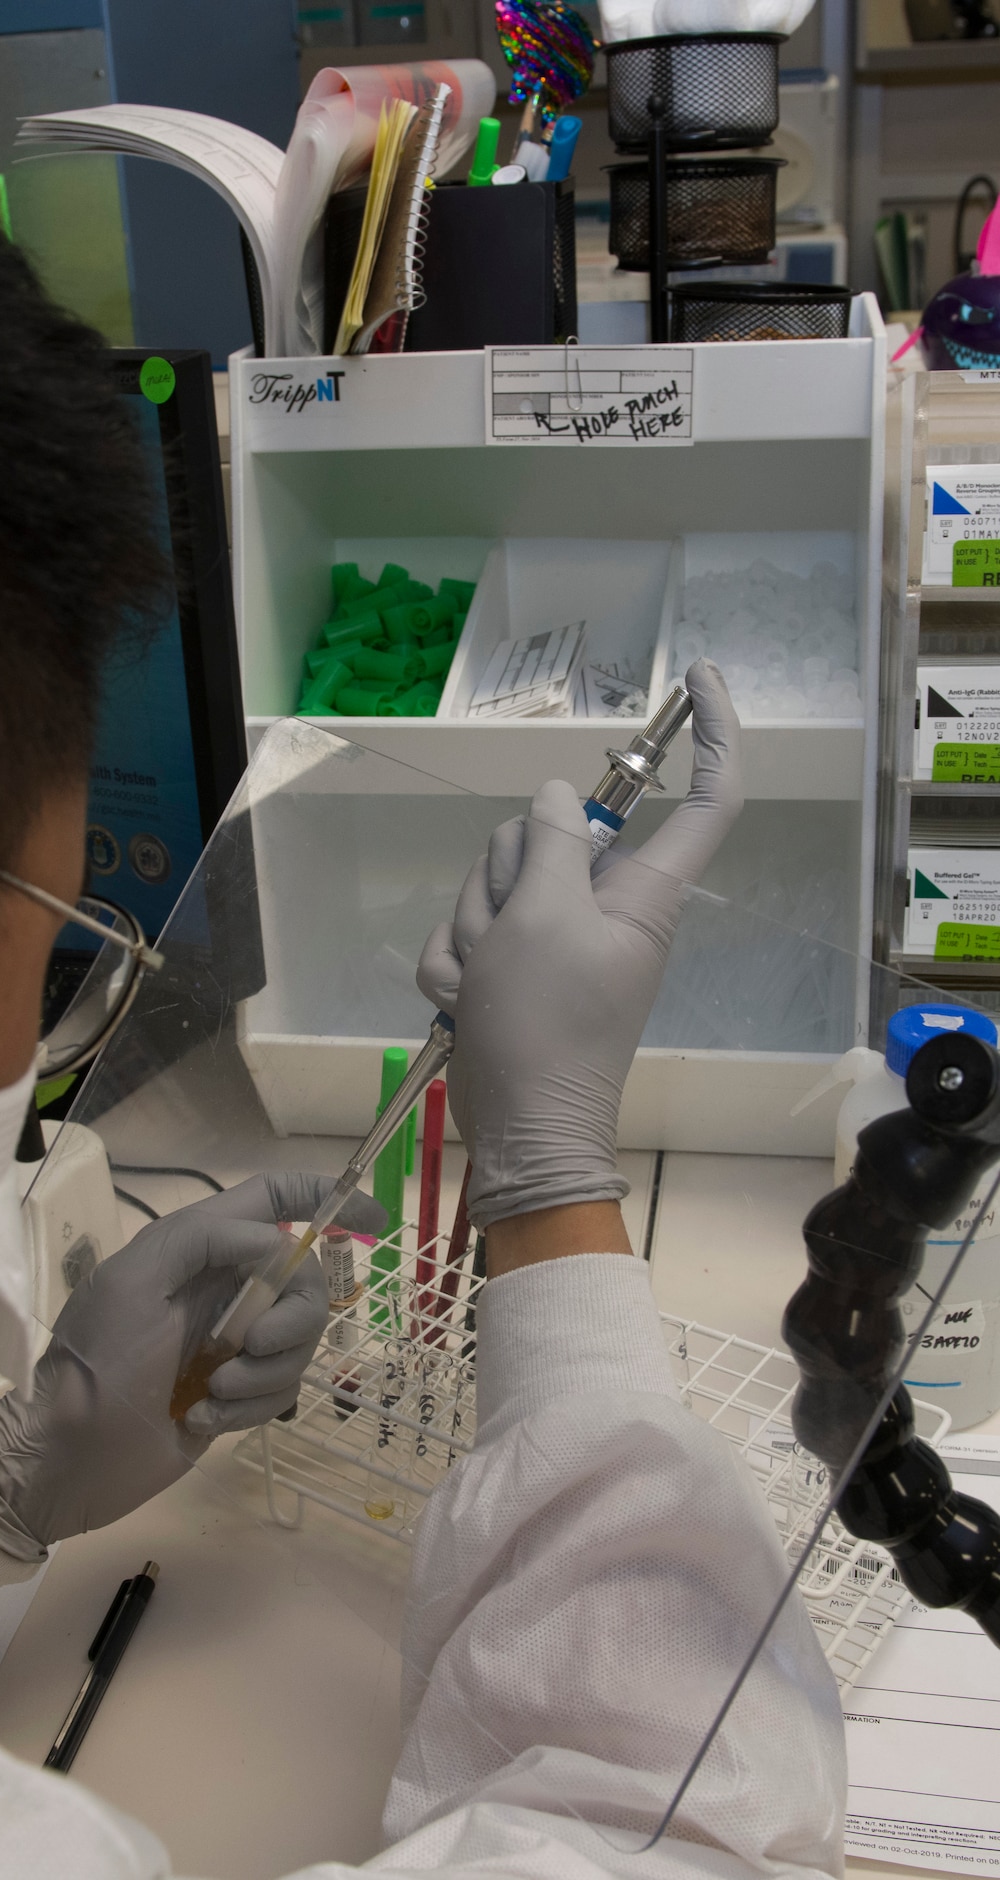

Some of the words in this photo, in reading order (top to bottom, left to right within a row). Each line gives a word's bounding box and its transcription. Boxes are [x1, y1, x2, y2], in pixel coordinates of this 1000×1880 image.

[249, 371, 345, 413] TrippNT
[572, 405, 619, 443] HOLE
[624, 379, 679, 425] PUNCH
[628, 404, 685, 442] HERE
[964, 518, 1000, 526] 06071
[113, 768, 156, 788] System
[962, 775, 1000, 783] REA
[911, 1832, 947, 1841] interpreting
[945, 1853, 974, 1863] Printed
